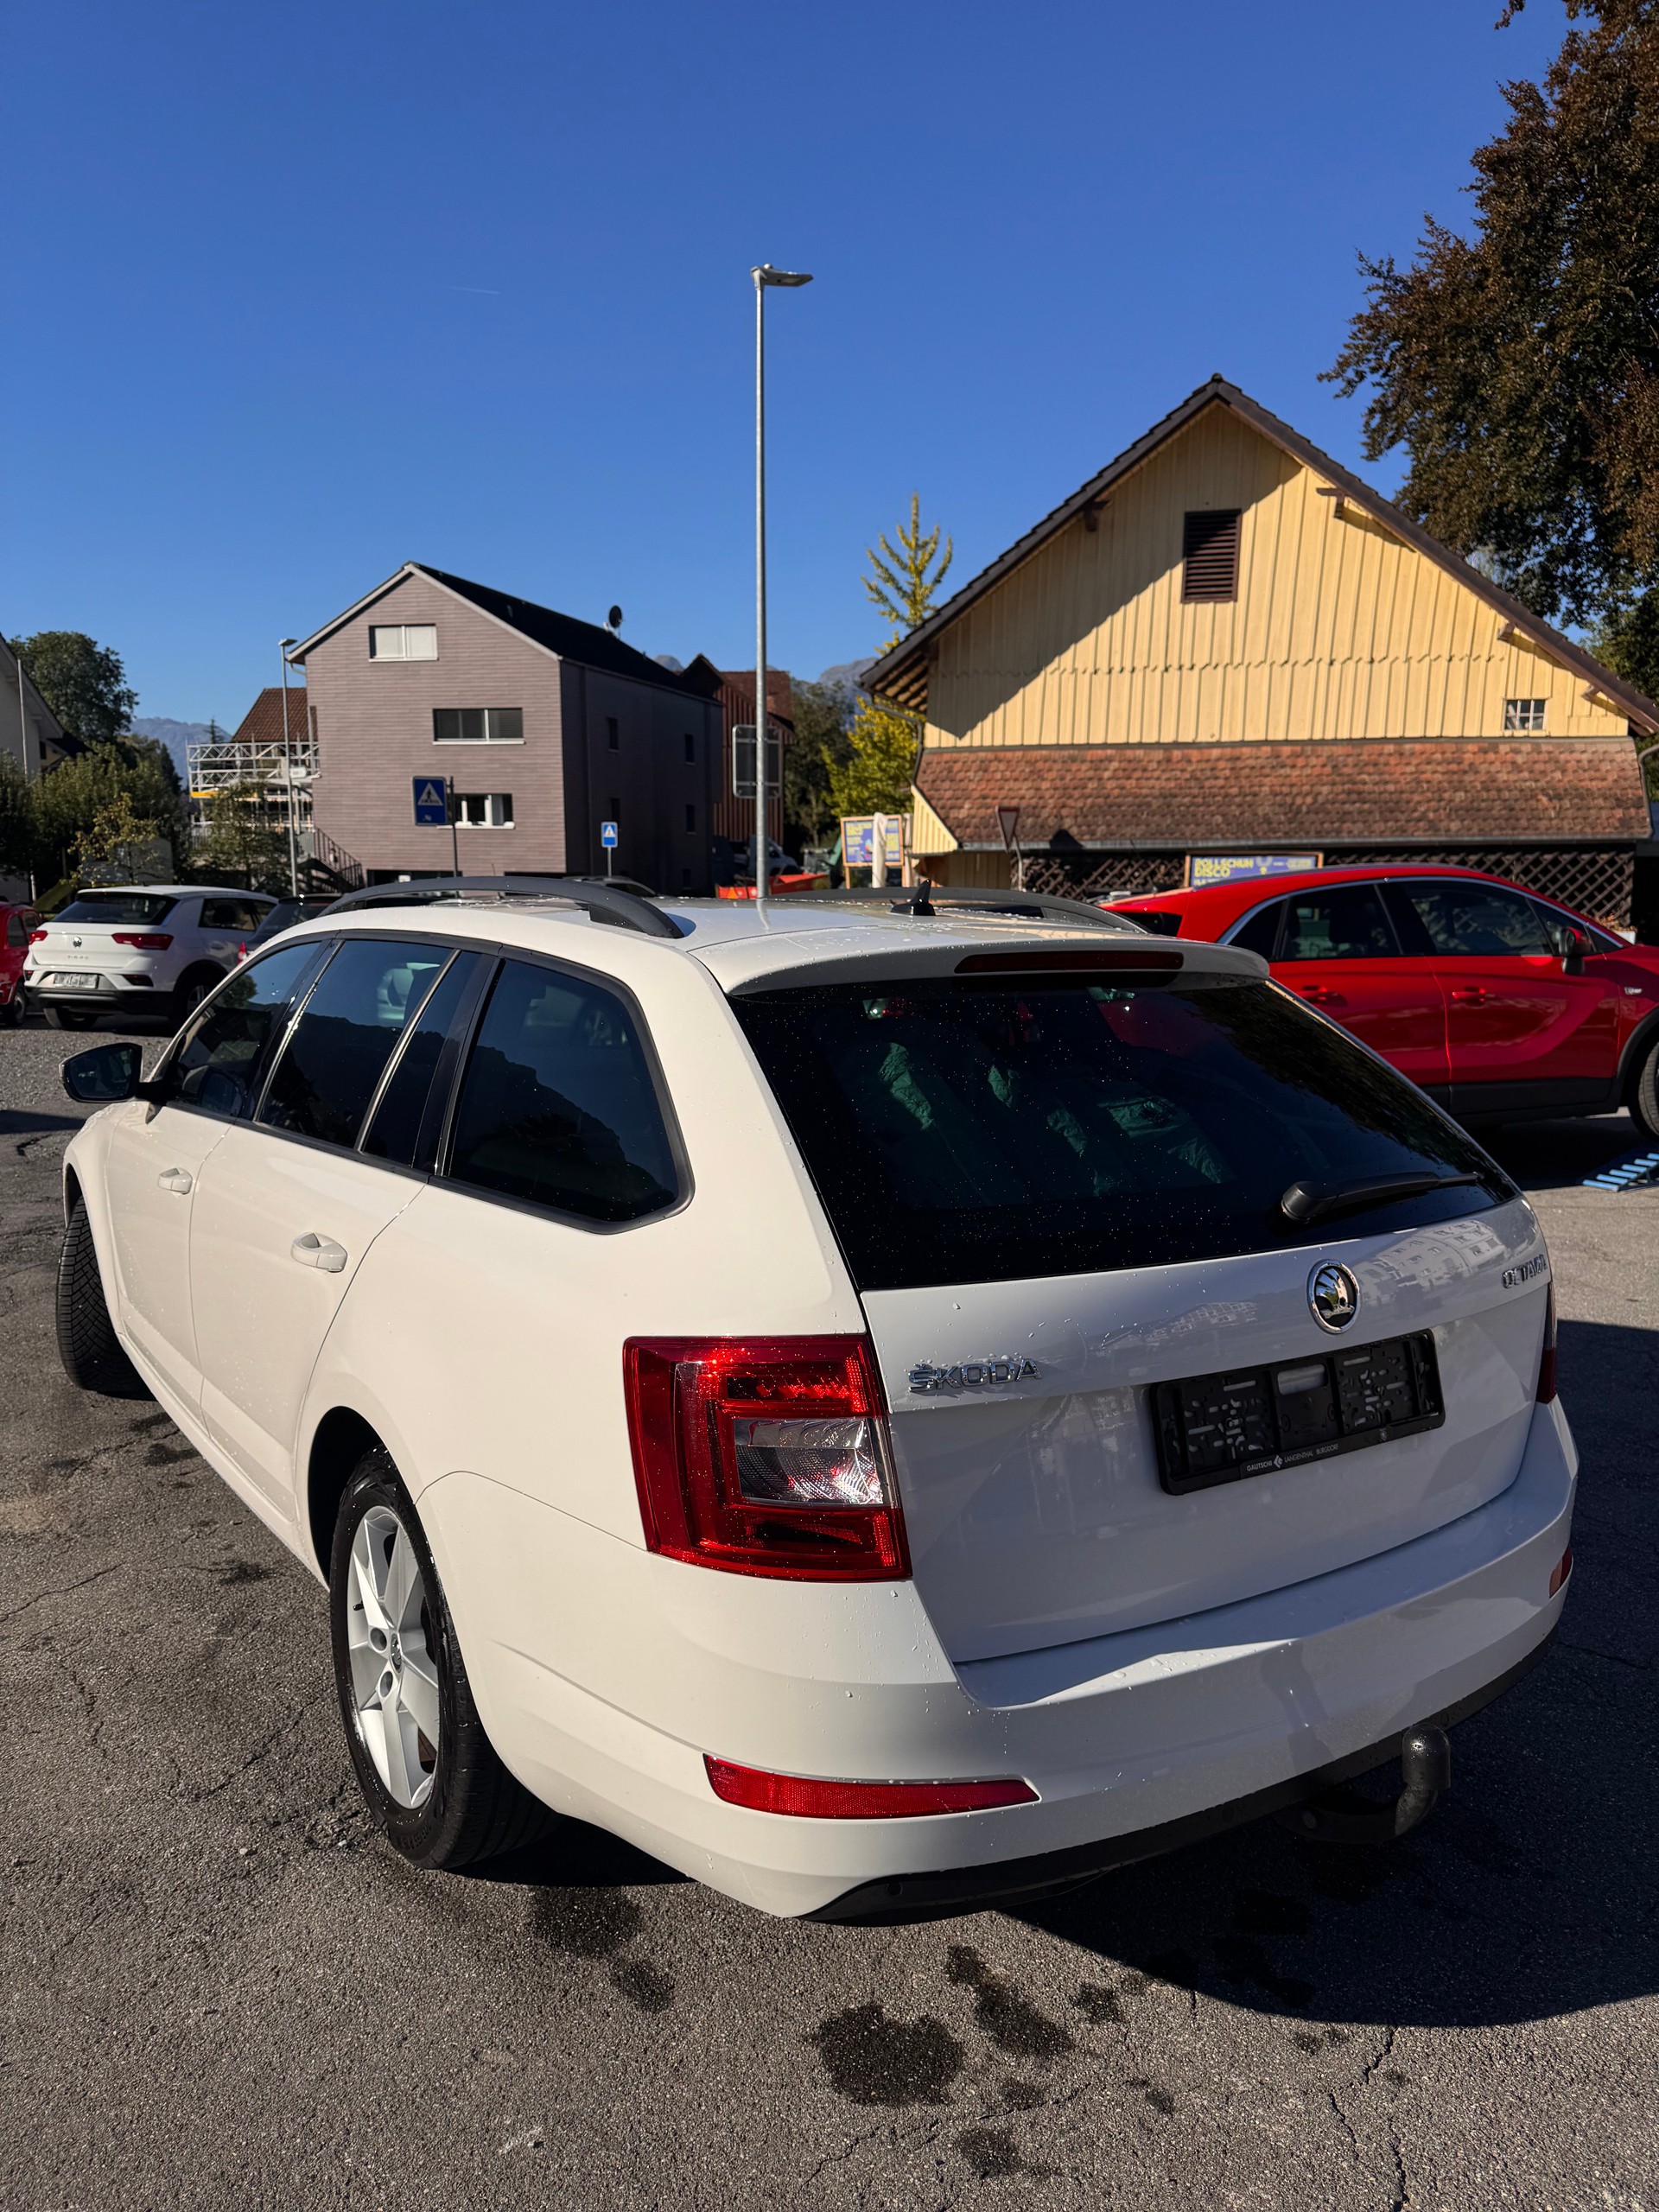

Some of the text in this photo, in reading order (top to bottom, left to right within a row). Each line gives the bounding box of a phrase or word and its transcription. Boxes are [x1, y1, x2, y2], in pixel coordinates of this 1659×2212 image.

[1194, 867, 1231, 878] DISCO
[1246, 1443, 1339, 1471] GAUTSCHI LANGENTHAL BURGDORF
